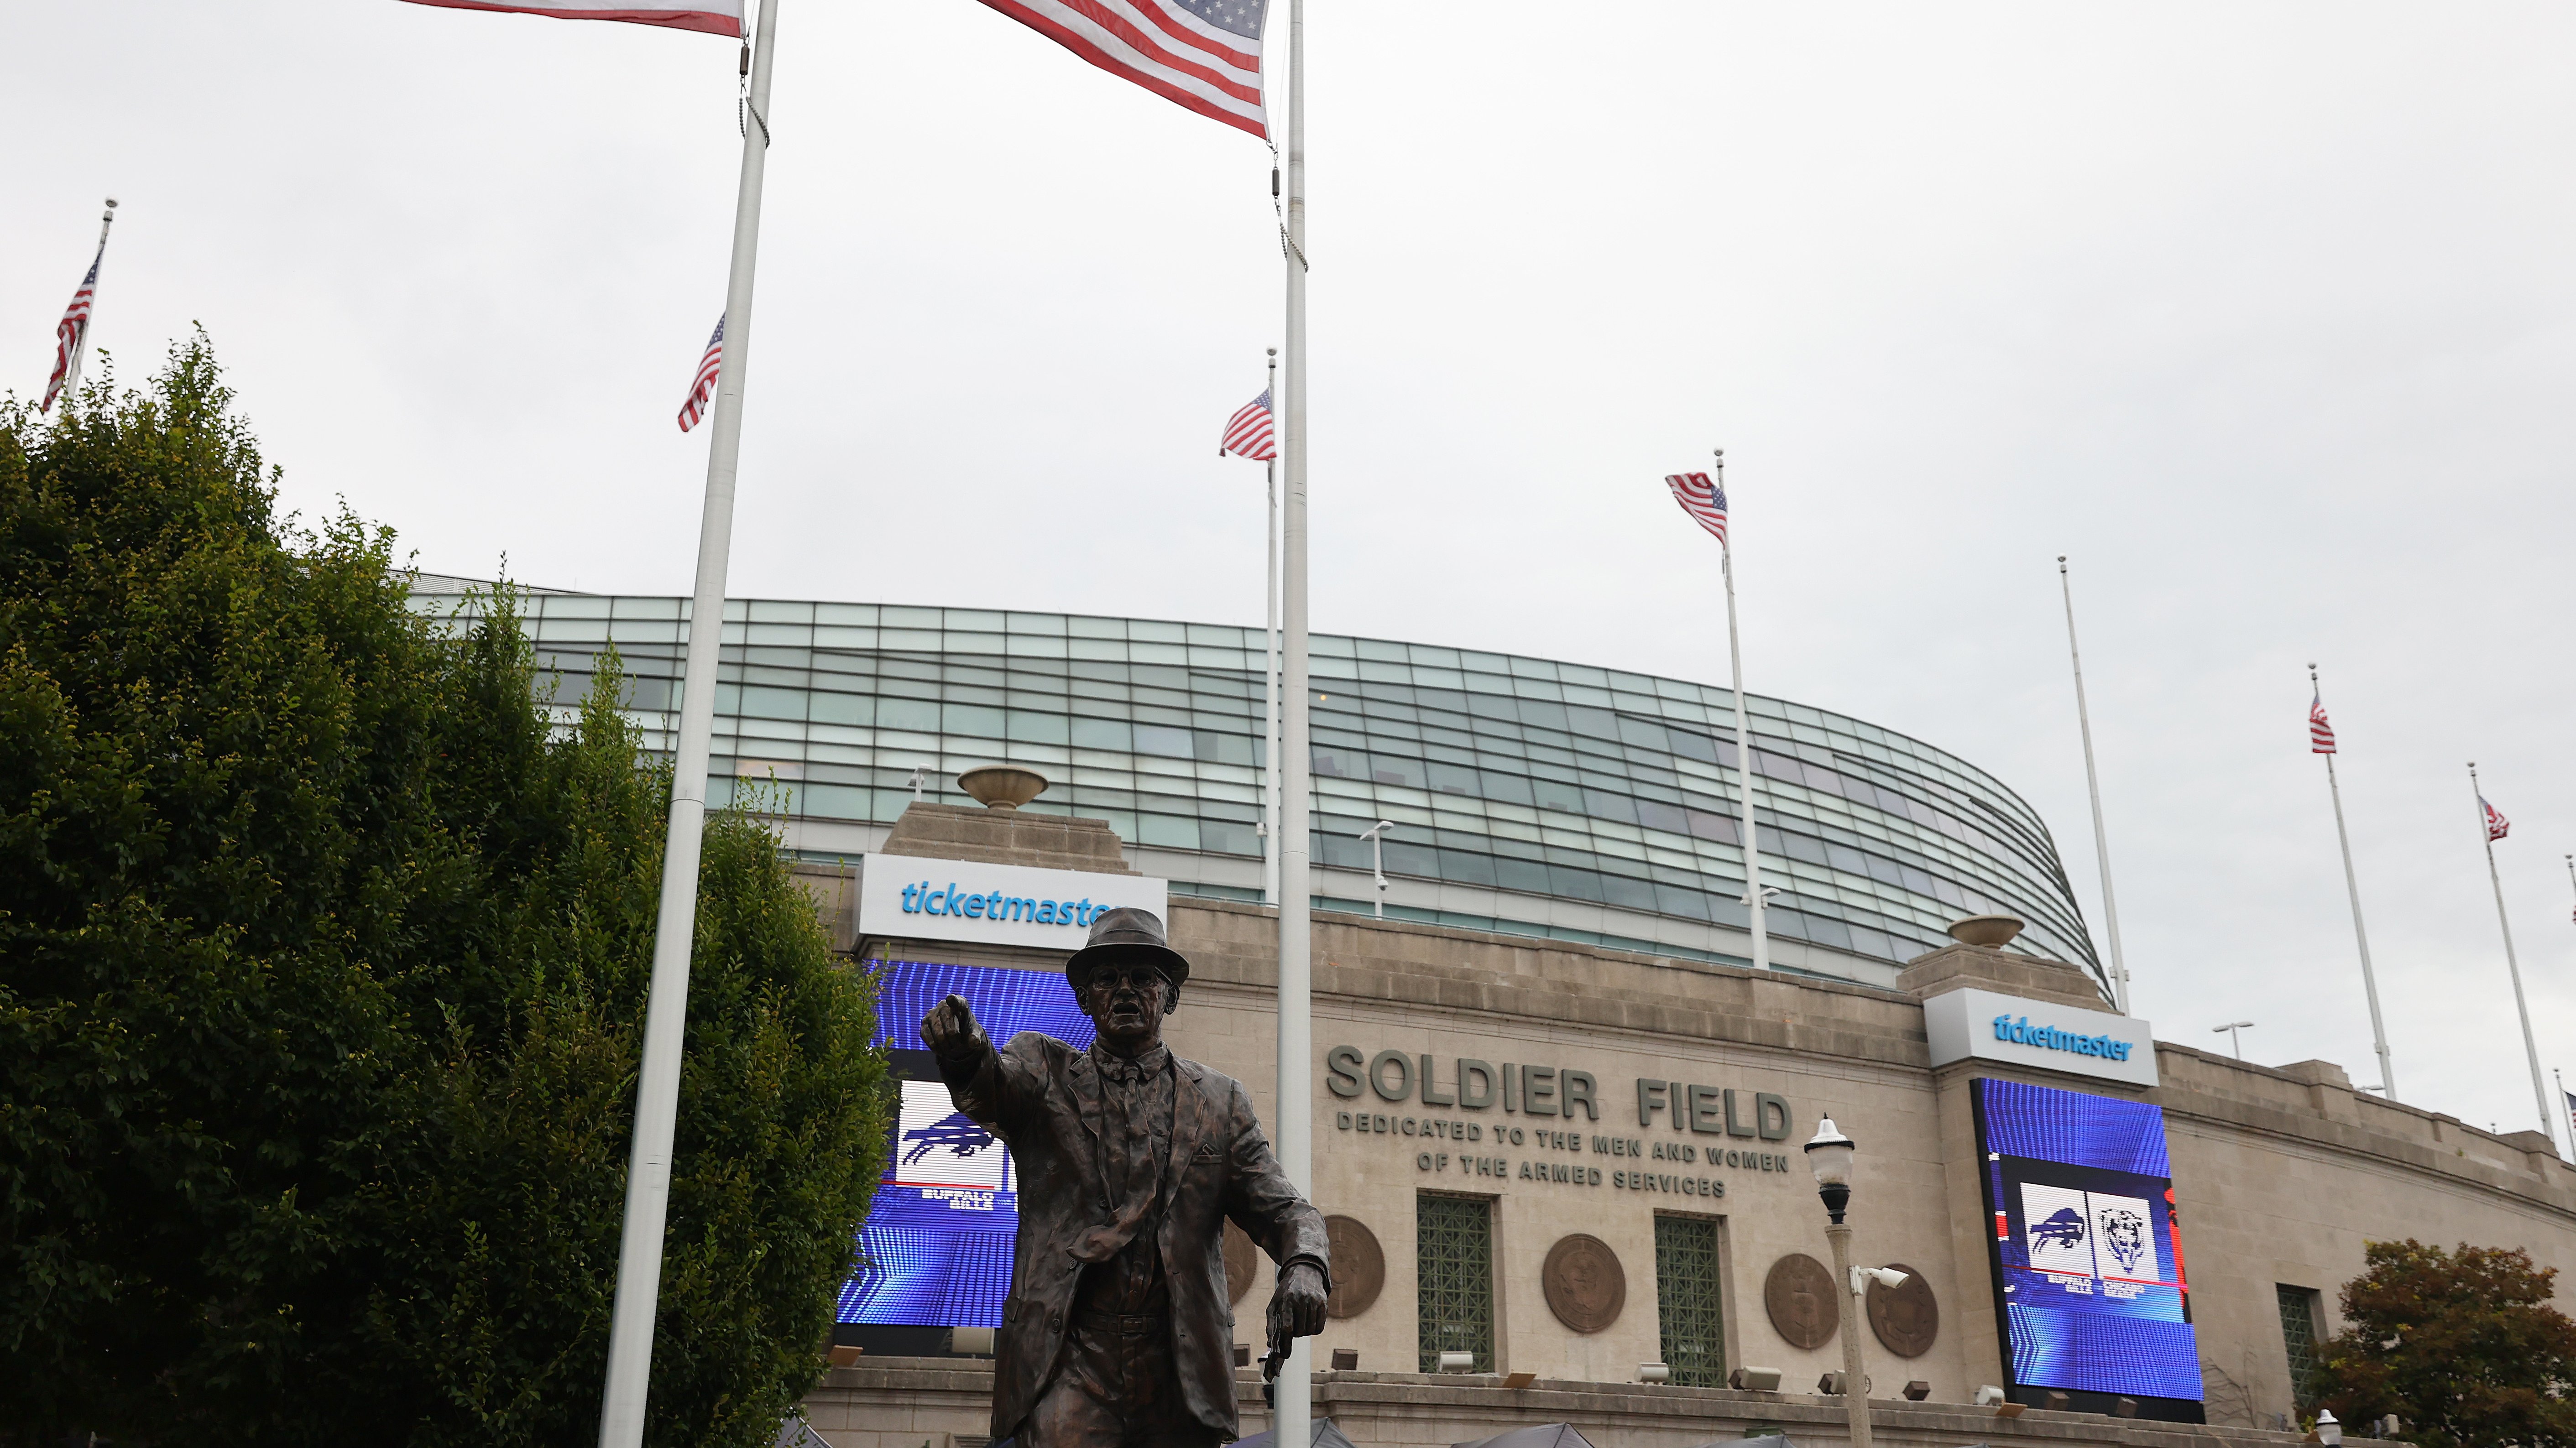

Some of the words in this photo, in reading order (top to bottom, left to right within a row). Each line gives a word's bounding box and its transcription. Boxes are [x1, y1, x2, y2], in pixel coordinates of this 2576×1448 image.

[902, 881, 1128, 927] ticketmaste
[1993, 1014, 2133, 1061] ticketmaster
[1327, 1045, 1599, 1120] SOLDIER
[1637, 1078, 1792, 1140] FIELD
[1338, 1111, 1483, 1141] DEDICATED
[1494, 1125, 1525, 1145] TO
[1536, 1129, 1582, 1150] THE
[1593, 1135, 1641, 1156] MEN
[1652, 1142, 1697, 1162] AND
[1707, 1146, 1789, 1172] WOMEN
[922, 1189, 994, 1202] BUFFALO
[1418, 1152, 1448, 1172] OF
[1460, 1156, 1507, 1177] THE
[1519, 1162, 1603, 1186] ARMED
[1613, 1170, 1725, 1198] SERVICES
[949, 1199, 994, 1211] BILLS
